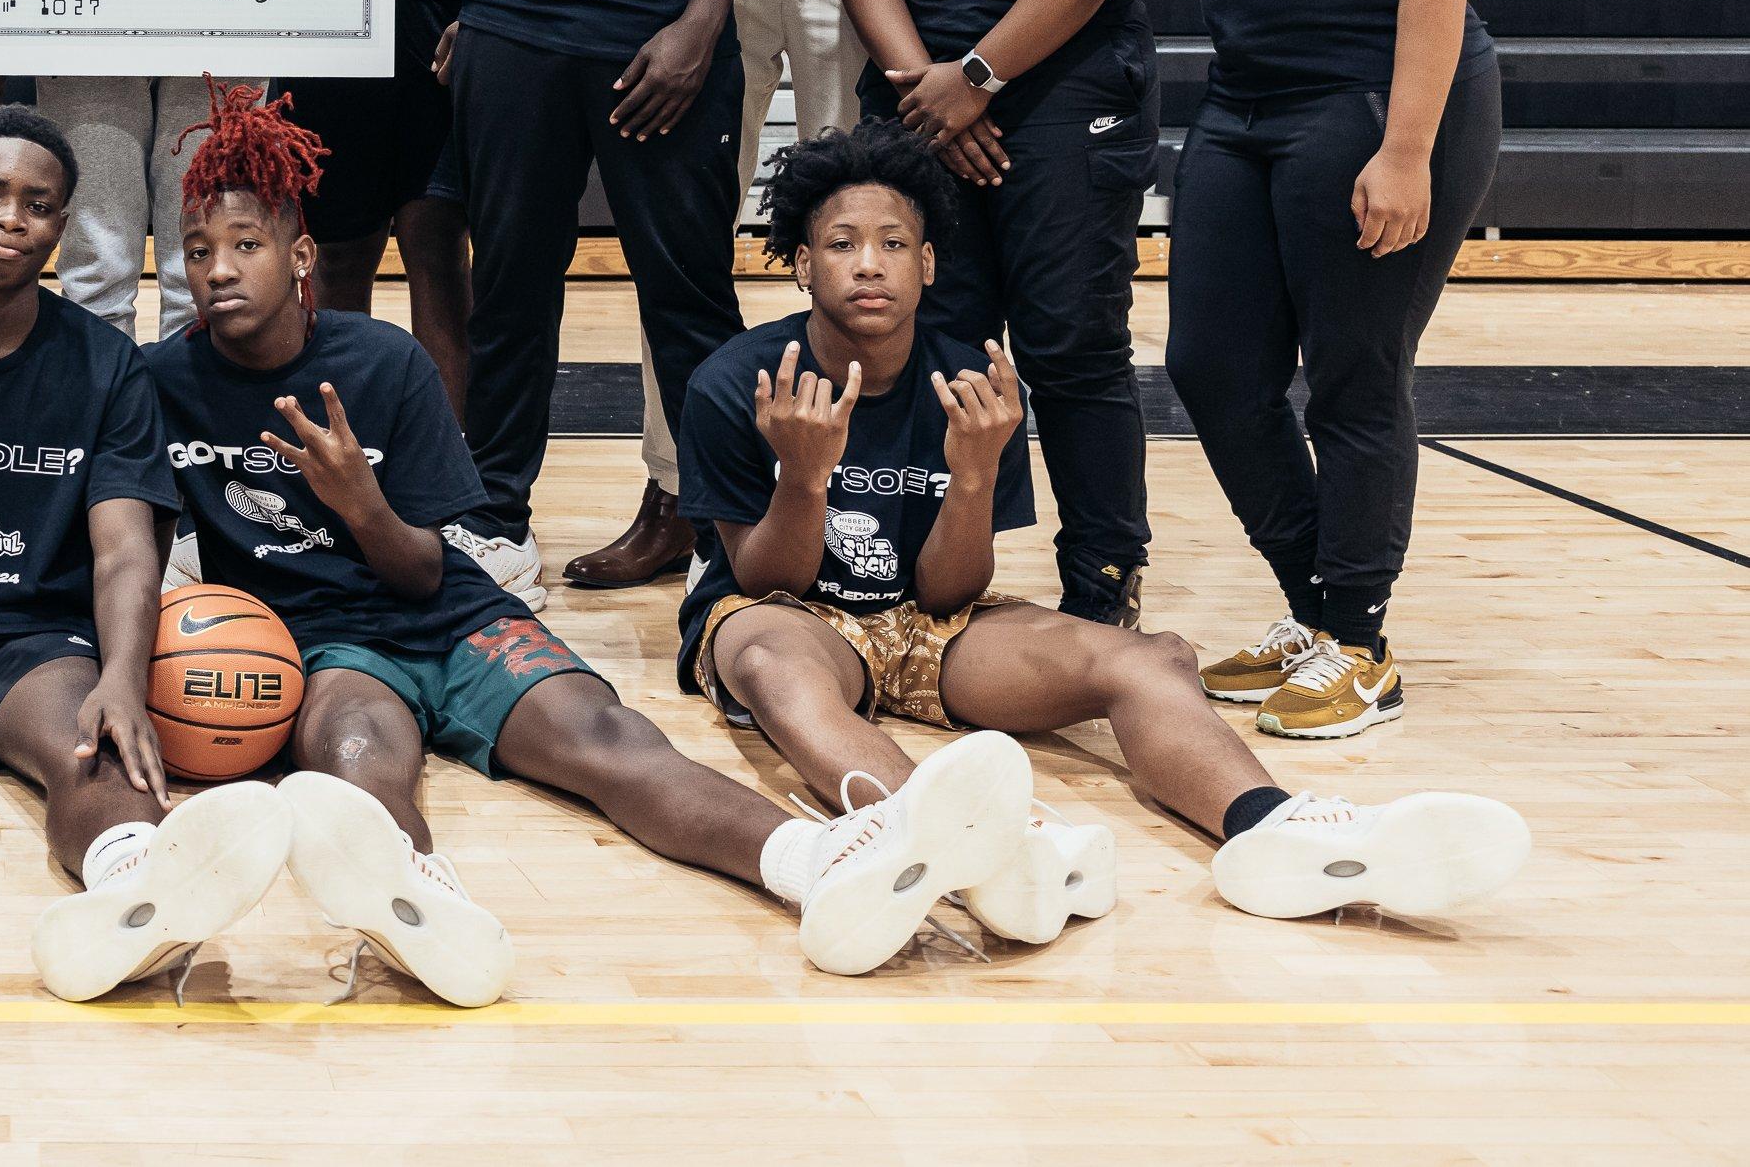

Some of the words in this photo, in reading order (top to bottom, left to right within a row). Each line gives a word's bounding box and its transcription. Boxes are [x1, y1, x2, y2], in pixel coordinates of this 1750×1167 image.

[1093, 115, 1117, 127] NIKE
[839, 517, 871, 525] HIBBETT
[842, 536, 891, 558] SOLE
[184, 668, 282, 701] ELITE
[183, 698, 281, 710] CHAMPIONSHIP
